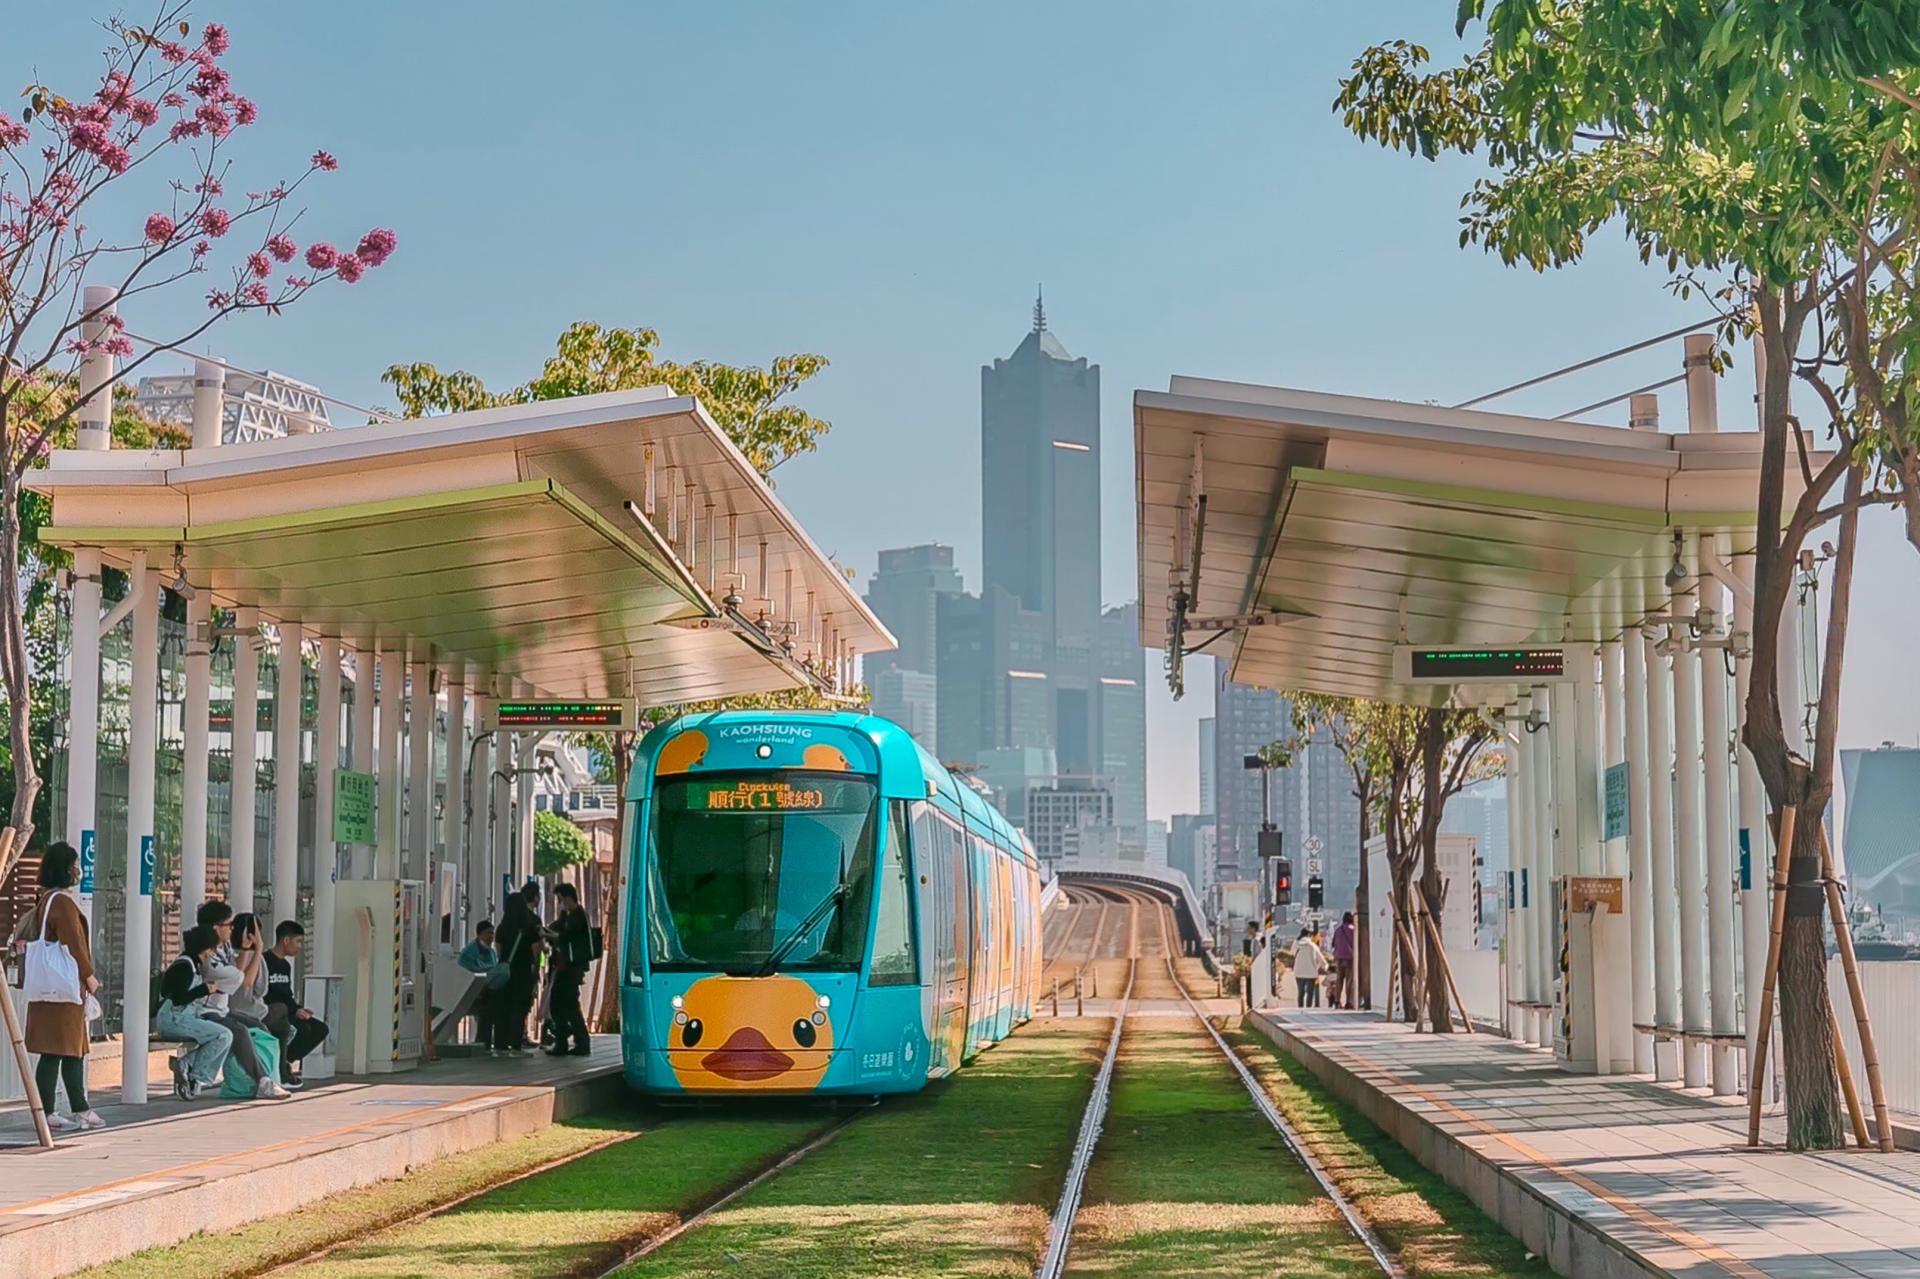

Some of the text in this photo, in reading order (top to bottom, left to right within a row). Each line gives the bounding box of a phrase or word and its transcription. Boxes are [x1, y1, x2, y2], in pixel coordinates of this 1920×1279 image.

[720, 725, 812, 738] KAOHSIUNG
[736, 735, 795, 744] wonderland
[1309, 839, 1321, 851] 30
